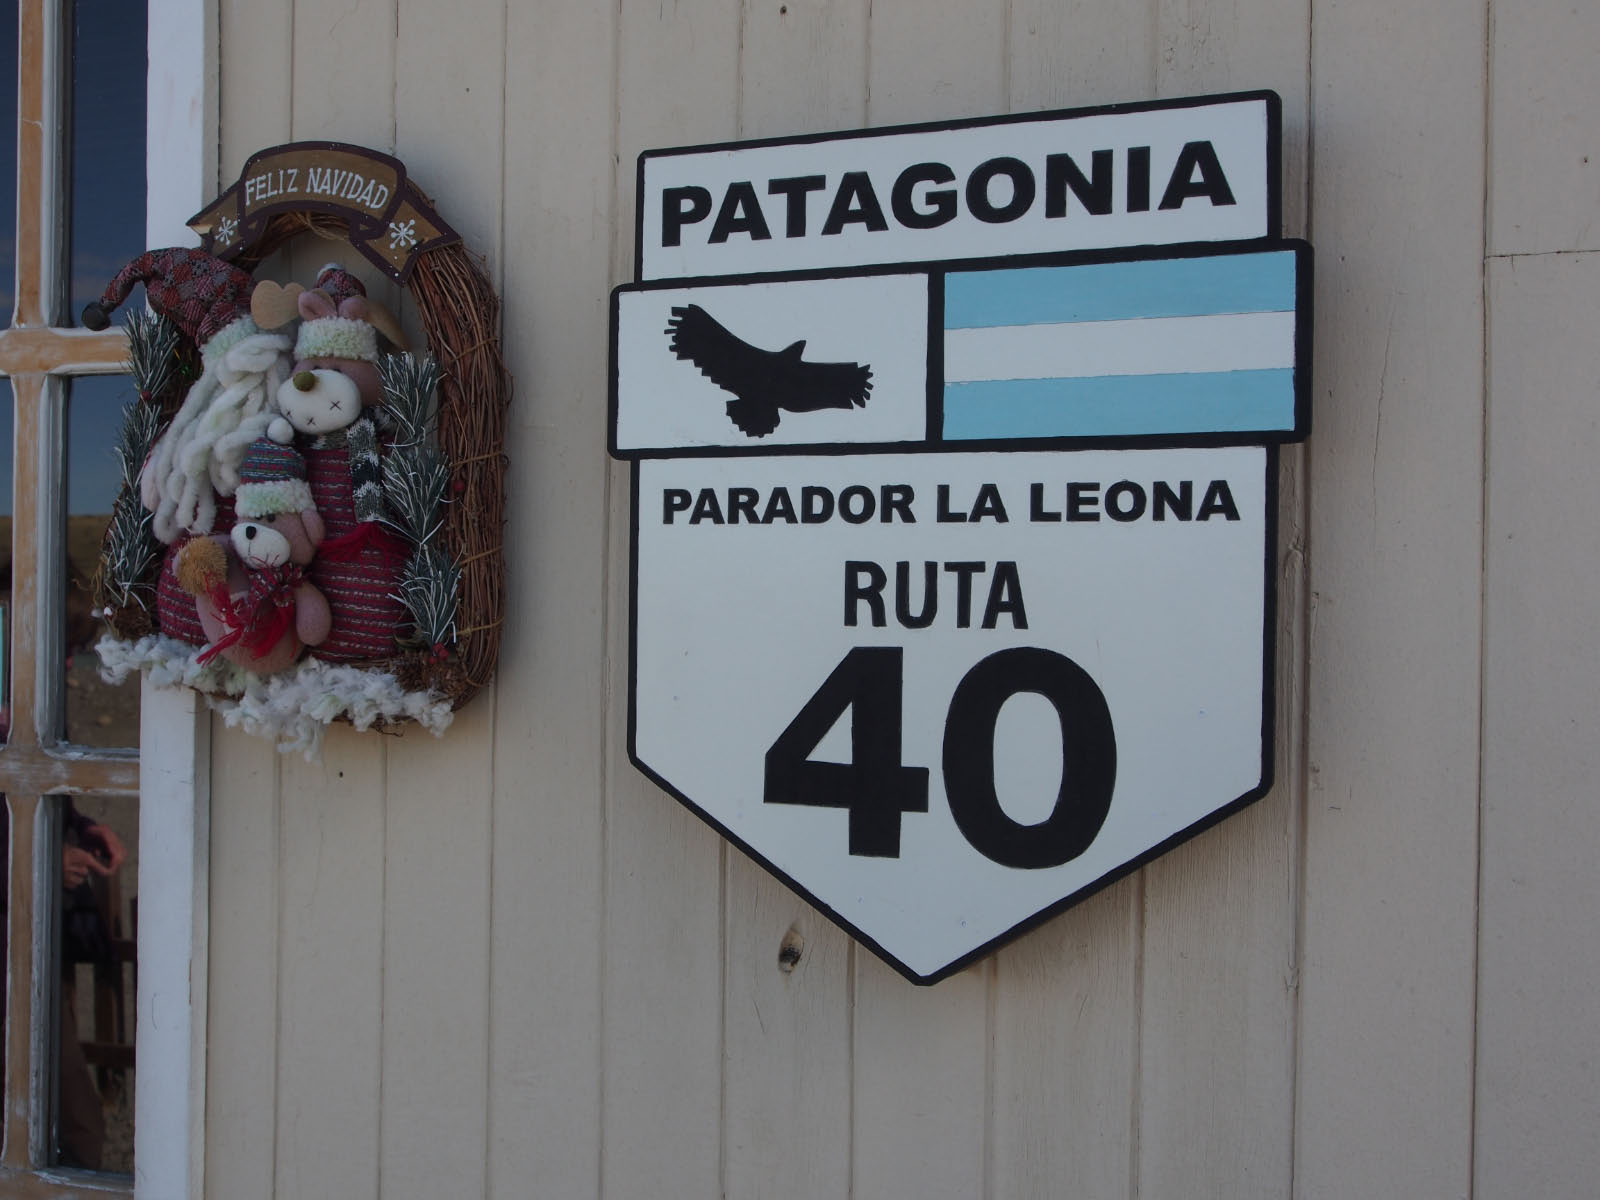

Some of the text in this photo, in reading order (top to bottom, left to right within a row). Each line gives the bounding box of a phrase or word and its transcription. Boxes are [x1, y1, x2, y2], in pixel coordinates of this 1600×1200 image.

[244, 167, 390, 209] FELIZ NAVIDAD
[661, 140, 1237, 248] PATAGONIA
[662, 479, 1241, 525] PARADOR LA LEONA
[843, 560, 1029, 630] RUTA
[763, 646, 1118, 870] 40
